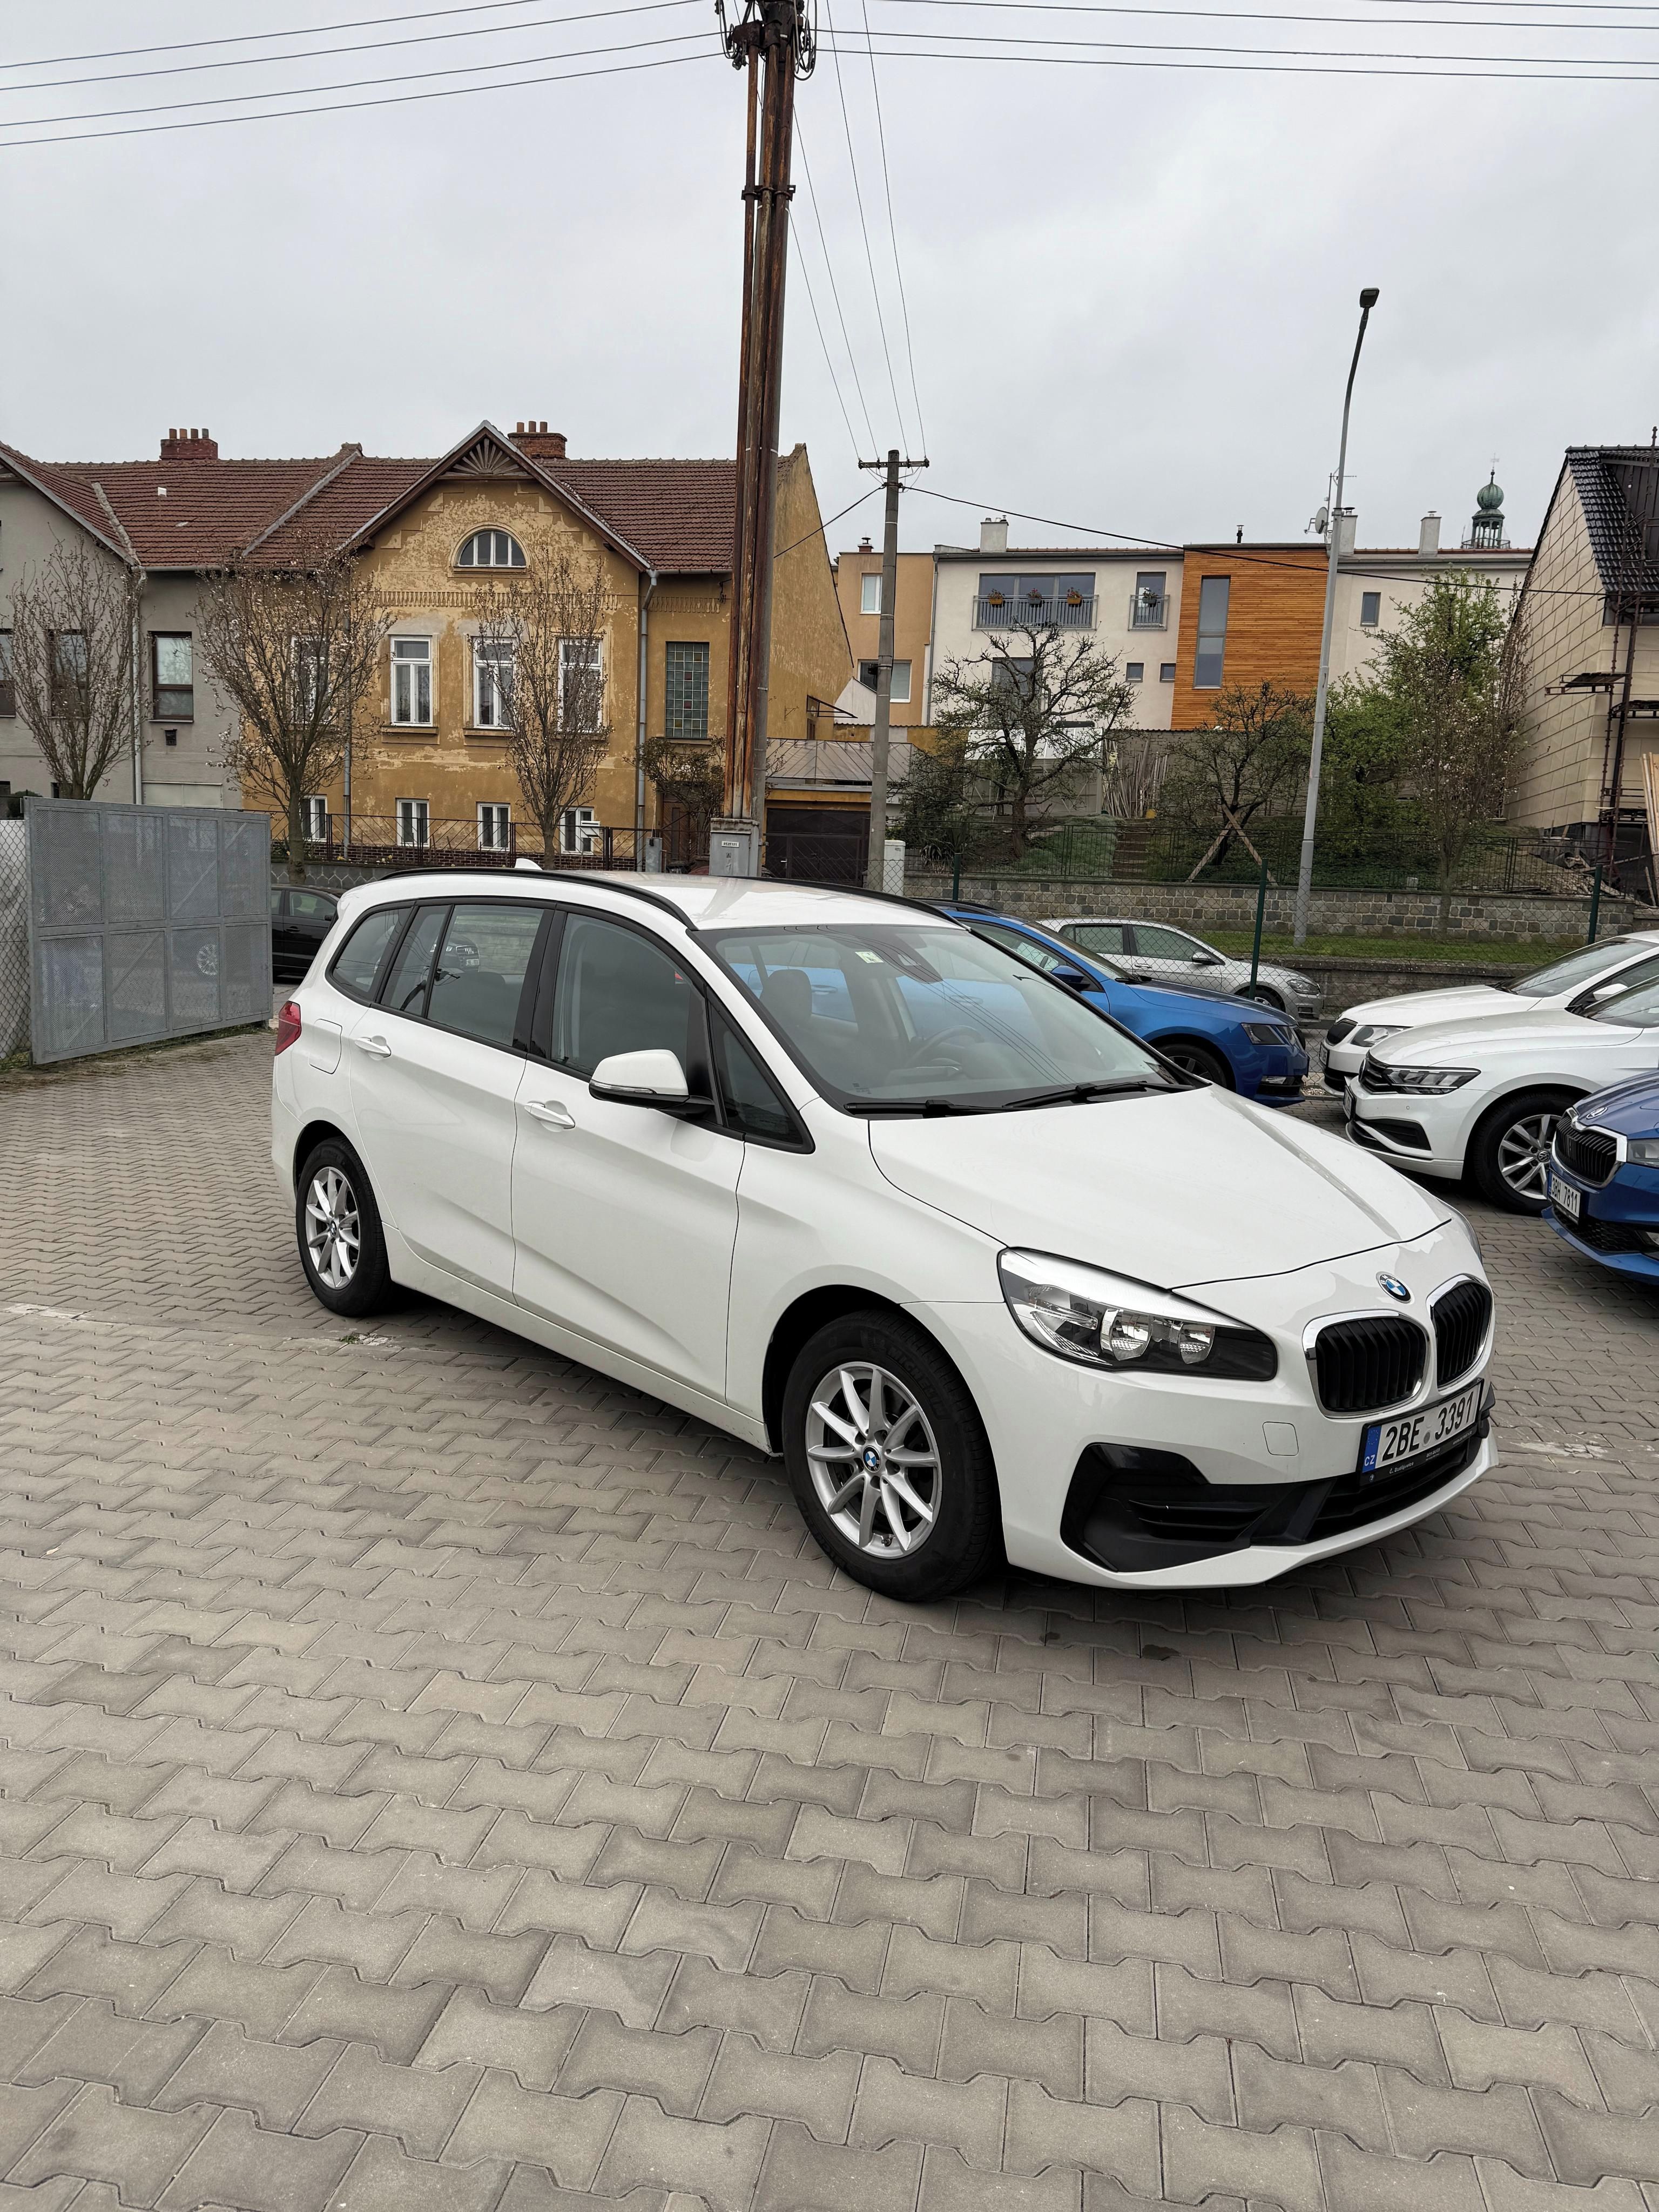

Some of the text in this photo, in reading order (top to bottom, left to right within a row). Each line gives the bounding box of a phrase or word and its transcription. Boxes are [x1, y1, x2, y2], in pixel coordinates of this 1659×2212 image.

[1552, 1177, 1577, 1213] 3BH 7811
[1381, 1391, 1474, 1461] 2BE 3391
[1364, 1454, 1375, 1467] CZ
